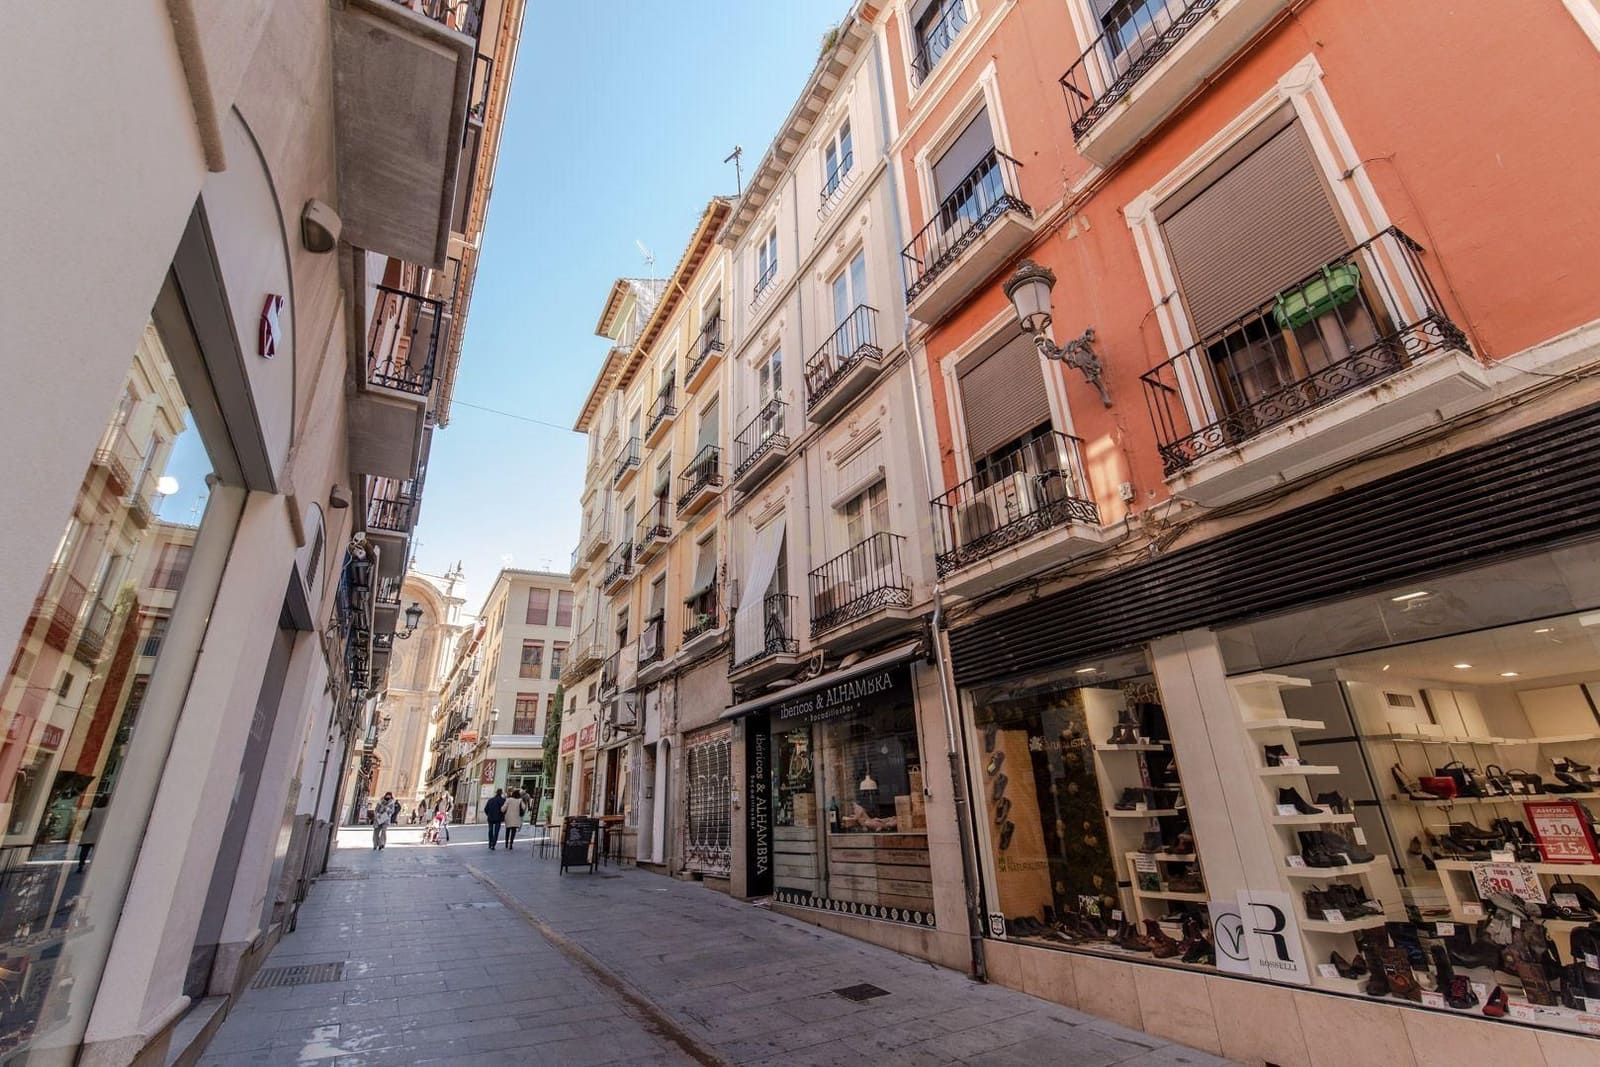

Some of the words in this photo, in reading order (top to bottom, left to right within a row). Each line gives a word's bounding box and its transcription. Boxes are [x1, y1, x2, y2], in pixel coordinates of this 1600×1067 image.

[816, 694, 824, 710] &
[826, 673, 893, 708] ALHAMBRA
[756, 783, 766, 793] &
[756, 797, 768, 876] ALHAMBRA
[1248, 902, 1295, 962] R
